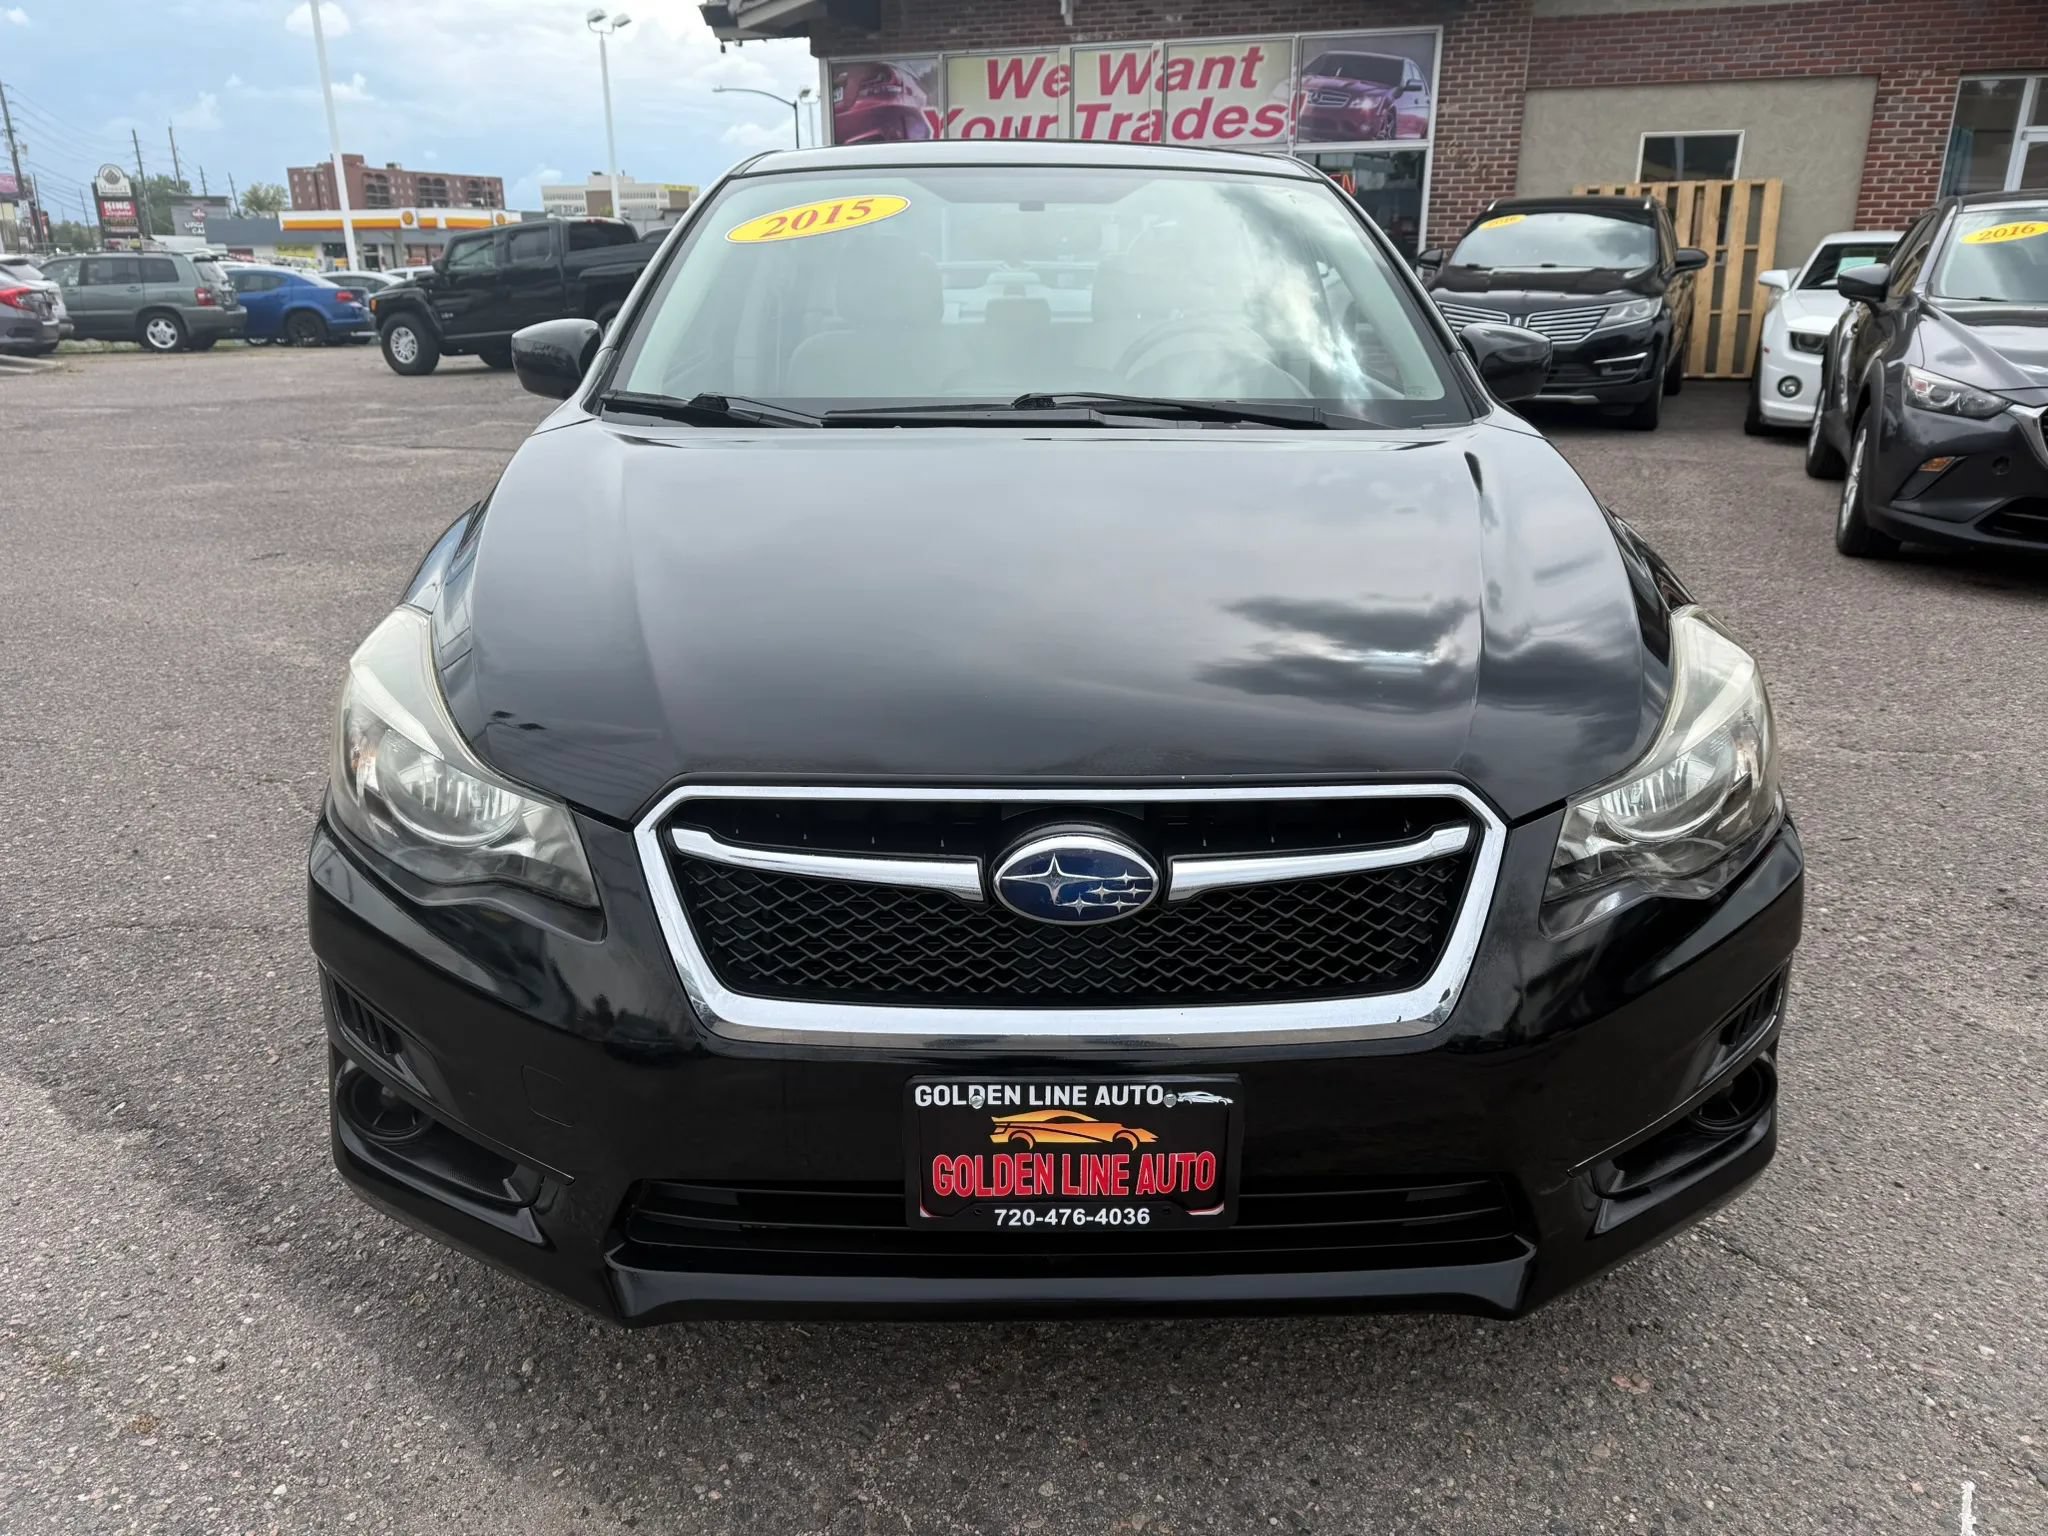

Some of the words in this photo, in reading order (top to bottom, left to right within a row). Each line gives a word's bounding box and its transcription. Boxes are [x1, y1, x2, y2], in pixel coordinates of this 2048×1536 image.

[986, 56, 1071, 101] We
[1098, 45, 1265, 97] Want
[1075, 92, 1307, 142] Trades!
[103, 200, 132, 210] KING
[760, 197, 875, 239] 2015
[1977, 223, 2036, 241] 2016
[914, 1084, 1021, 1108] GOLDEN
[1029, 1084, 1088, 1106] LINE
[1094, 1084, 1164, 1106] AUTO
[932, 1153, 1054, 1198] GOLDEN
[1061, 1153, 1130, 1196] LINE
[1135, 1150, 1217, 1195] AUTO
[994, 1208, 1151, 1227] 720-476-4036
